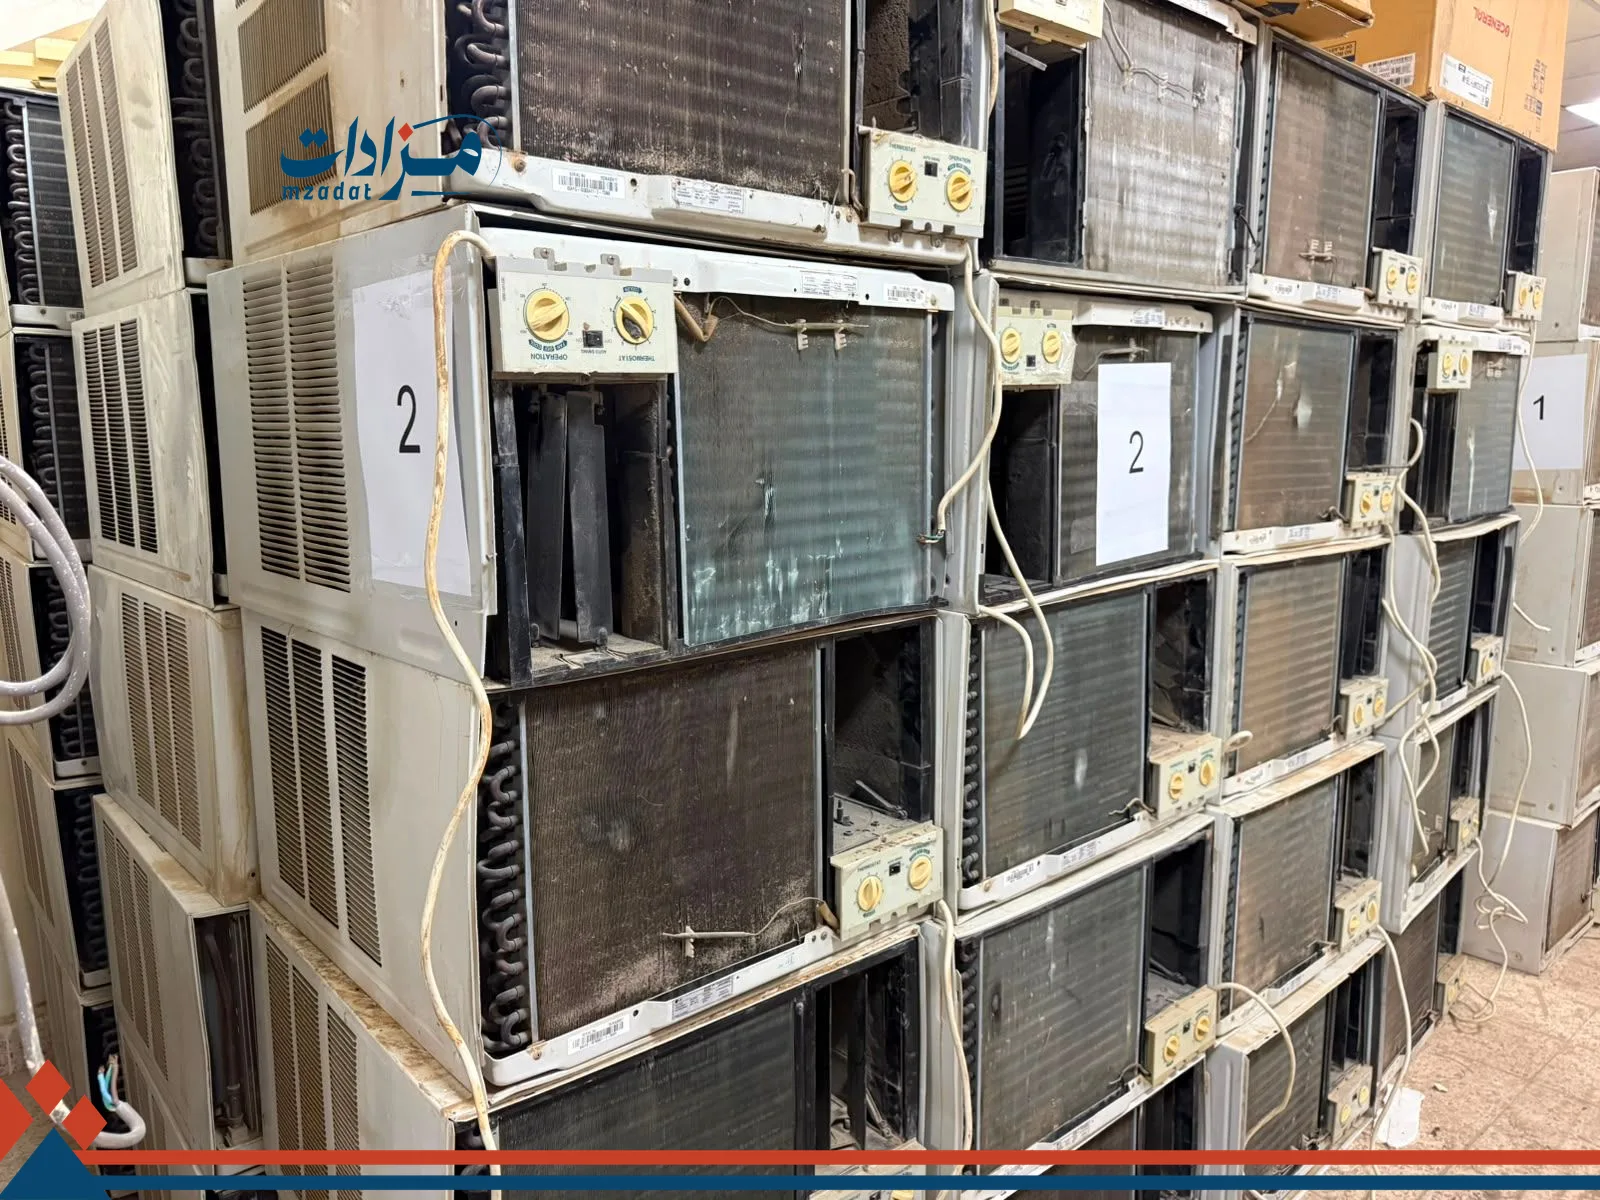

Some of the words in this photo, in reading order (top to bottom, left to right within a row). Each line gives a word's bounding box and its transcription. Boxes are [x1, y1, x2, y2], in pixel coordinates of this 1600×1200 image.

[530, 353, 568, 361] OPERATION
[397, 384, 420, 453] 2
[1533, 394, 1545, 420] 1
[1128, 430, 1144, 474] 2
